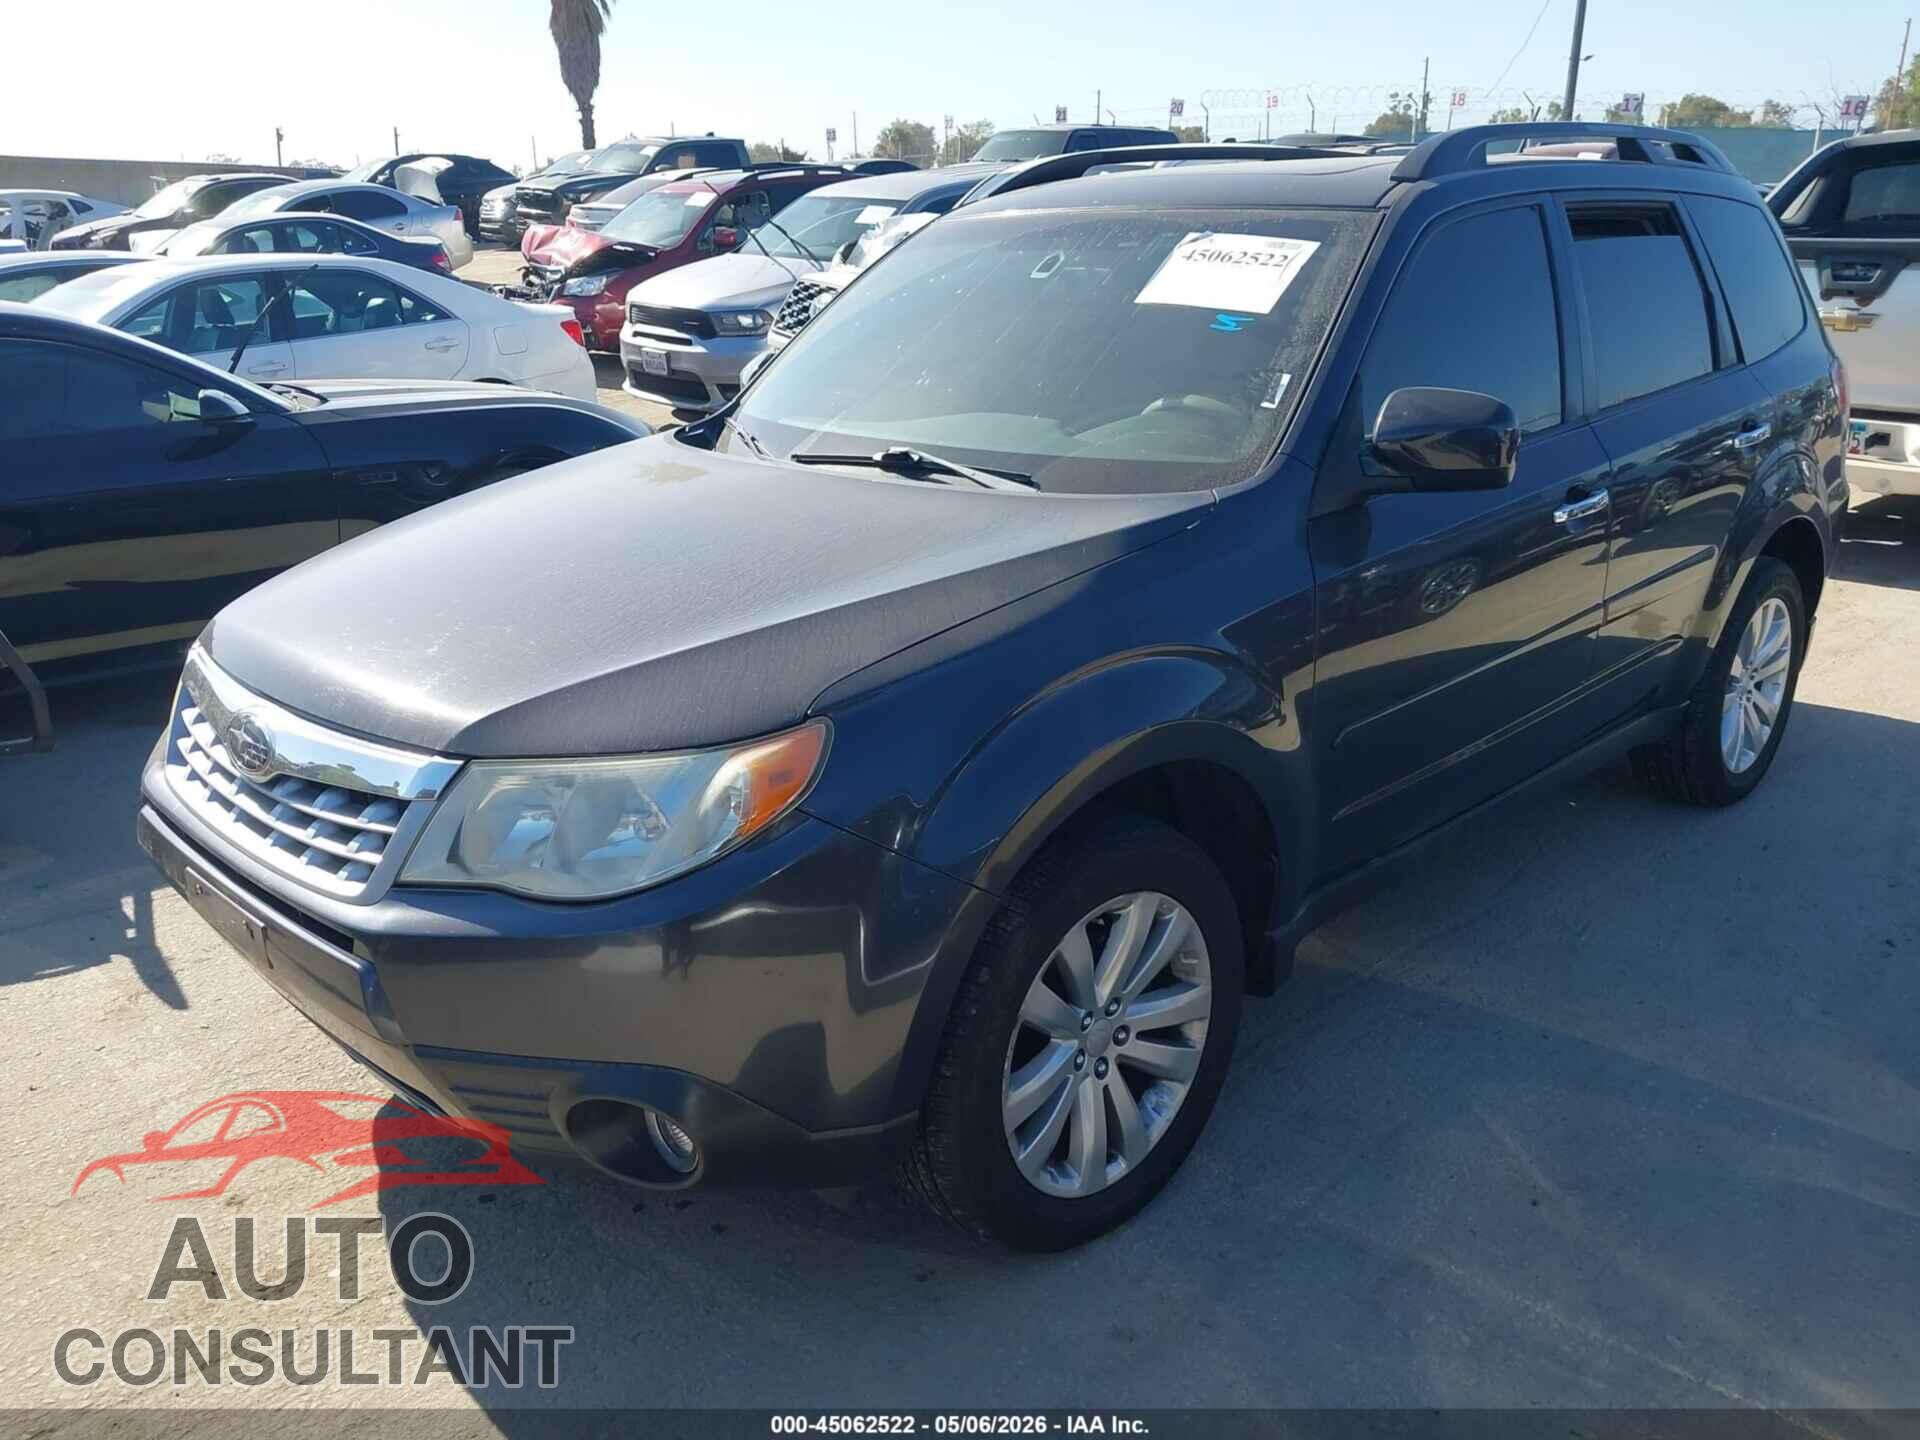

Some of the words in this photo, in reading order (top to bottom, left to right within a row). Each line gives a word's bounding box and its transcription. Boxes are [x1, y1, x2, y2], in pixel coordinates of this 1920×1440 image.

[1266, 95, 1278, 108] 19
[1450, 92, 1466, 106] 18
[1622, 97, 1641, 112] 17
[1170, 102, 1184, 114] 20
[1840, 100, 1865, 116] 16
[1056, 110, 1067, 122] 21
[1182, 248, 1289, 268] 45062522
